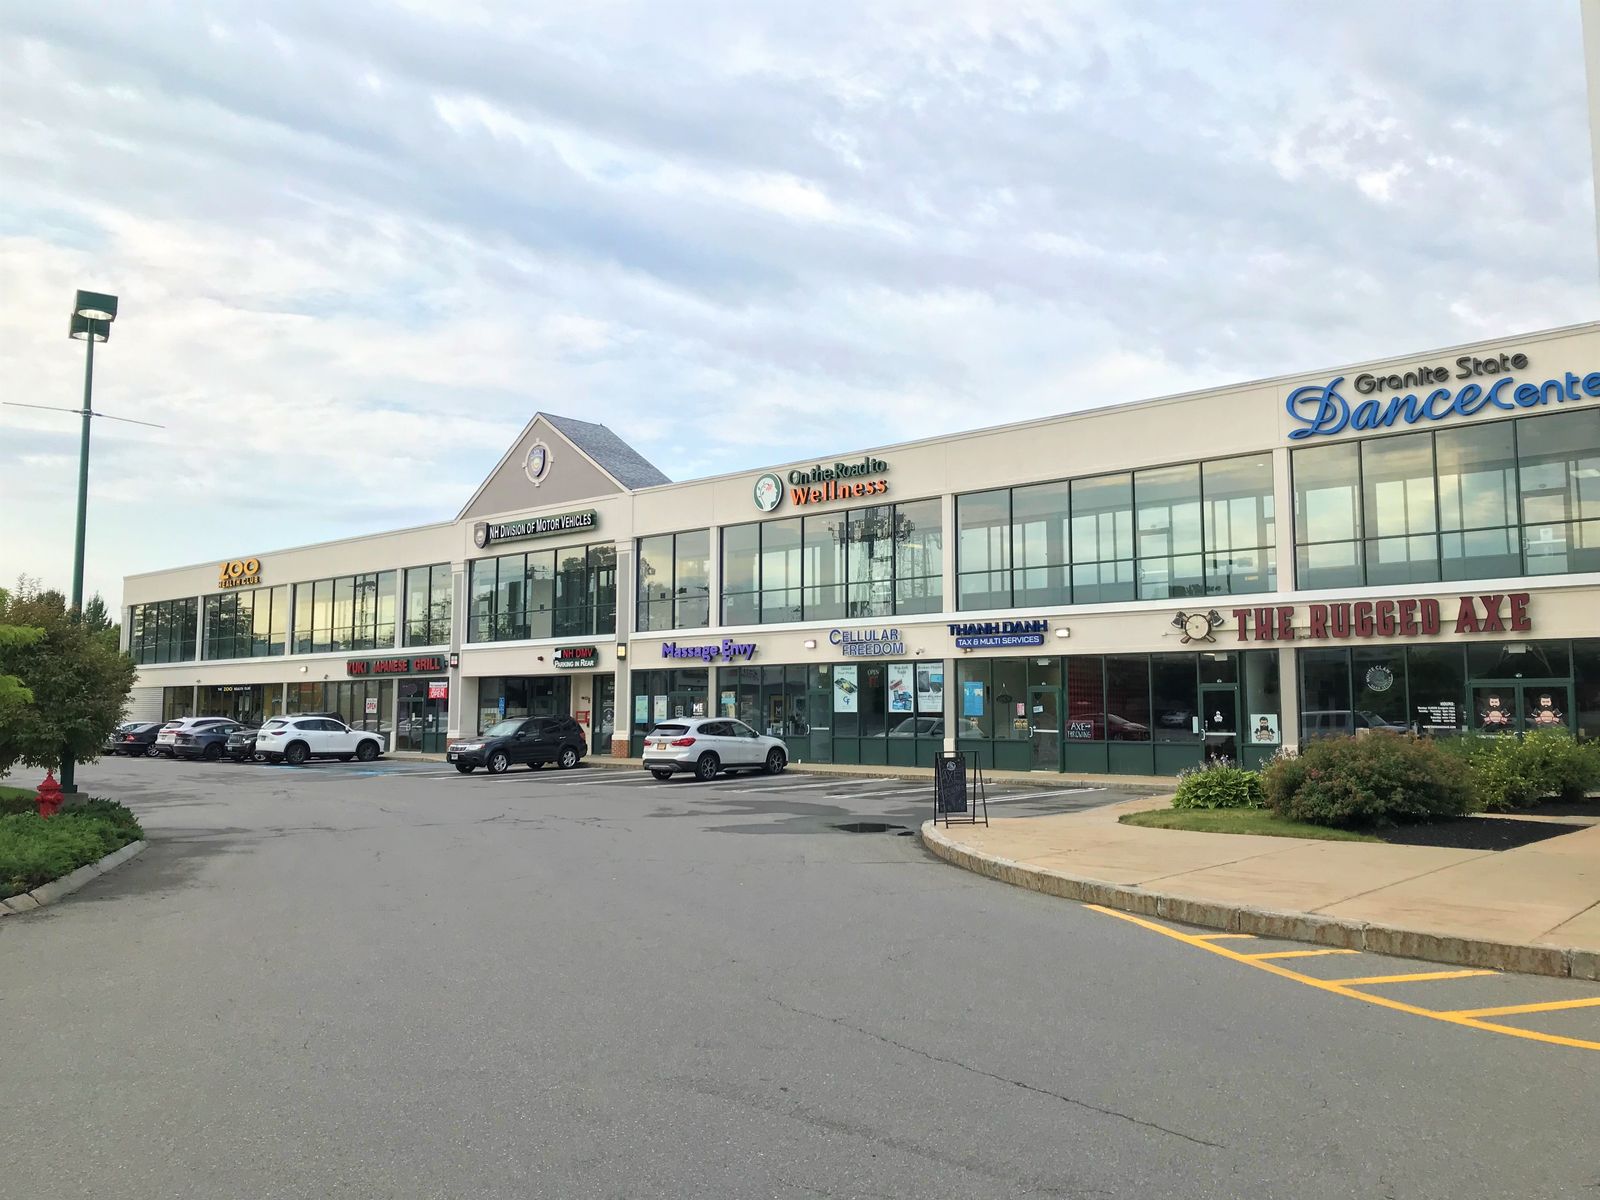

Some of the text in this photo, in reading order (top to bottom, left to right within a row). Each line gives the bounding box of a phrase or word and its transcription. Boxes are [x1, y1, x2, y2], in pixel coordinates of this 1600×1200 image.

[1354, 353, 1528, 394] Granite State
[788, 456, 888, 486] On the Road to
[790, 479, 888, 505] Wellness
[489, 513, 592, 539] NH DIVISION OF MOTOR VEHICLES
[218, 558, 261, 581] ZOO
[218, 575, 261, 589] HEALTH CLUB
[1232, 592, 1532, 642] THE RUGGED AXE
[947, 619, 1048, 636] THANH DANH
[828, 628, 899, 645] CELLULAR
[958, 635, 1040, 647] TAX & MULTI SERVICES
[562, 648, 593, 658] NH DMV
[661, 639, 757, 662] Massage Envy
[841, 642, 905, 656] FREEDOM
[372, 659, 409, 673] JAPANESE
[412, 657, 441, 670] GRILL
[554, 660, 574, 668] PARKING
[580, 659, 594, 667] REAR
[692, 702, 704, 713] ME
[1070, 721, 1086, 731] AXE
